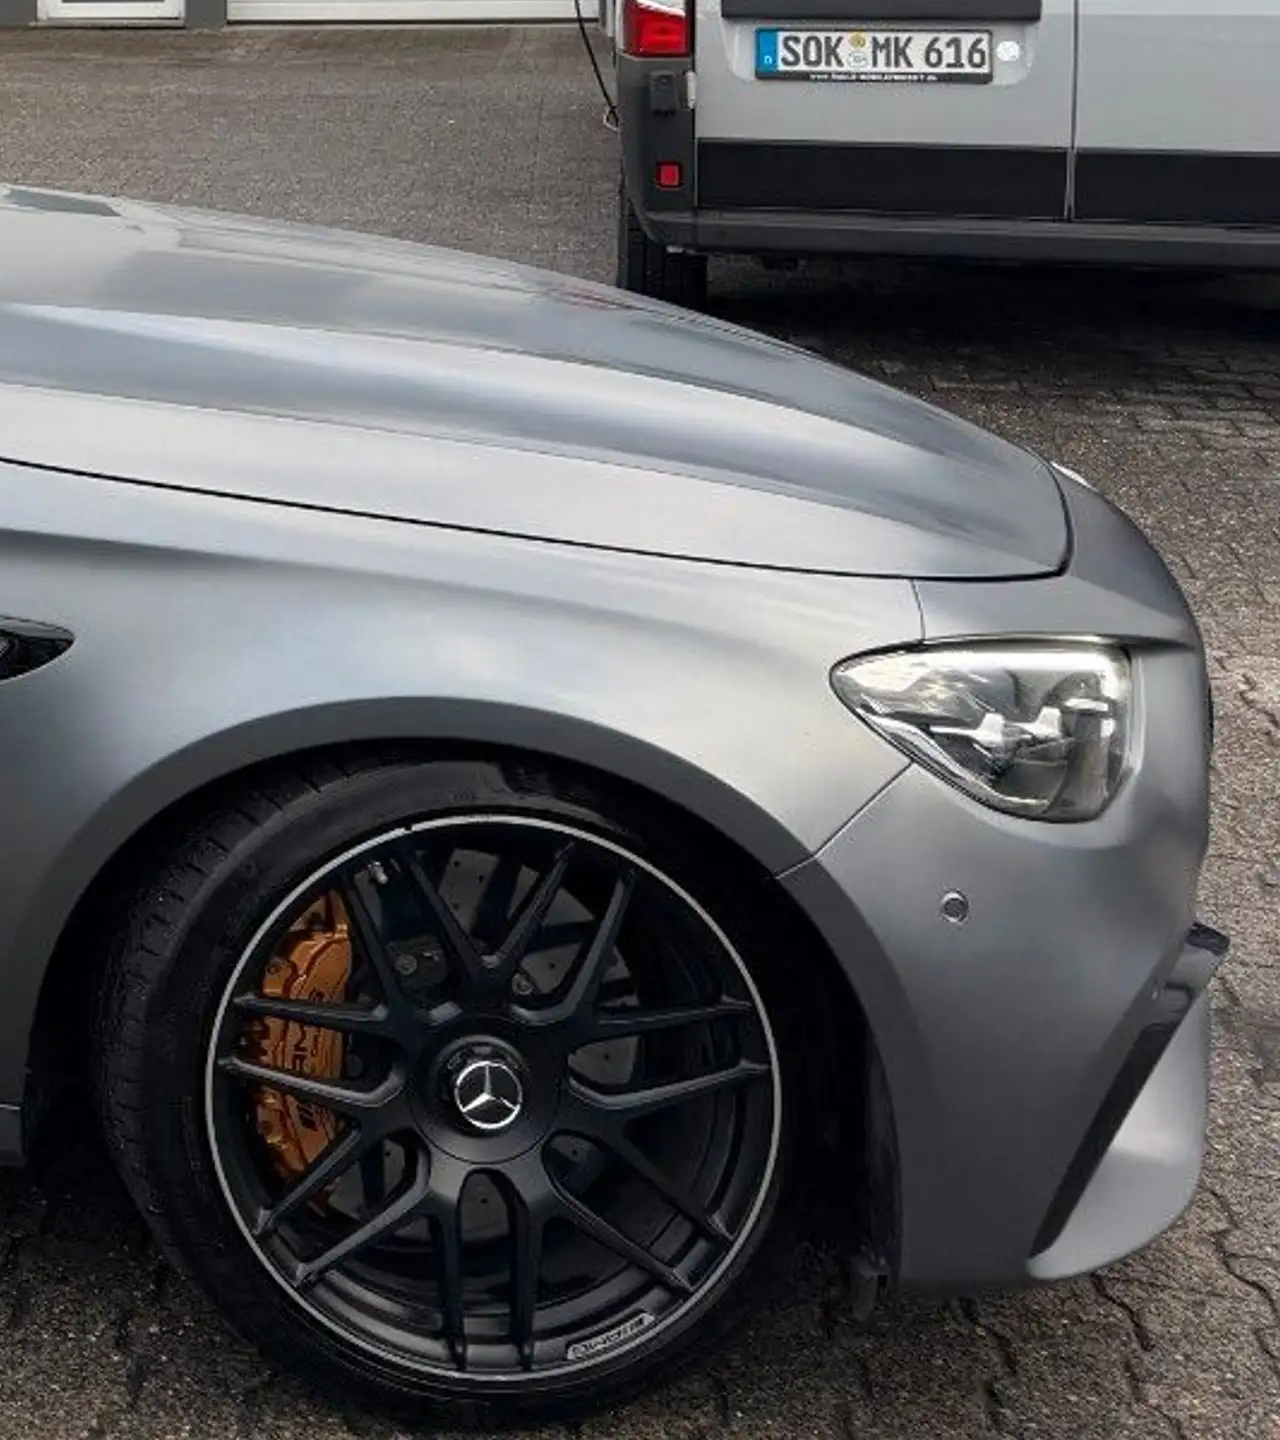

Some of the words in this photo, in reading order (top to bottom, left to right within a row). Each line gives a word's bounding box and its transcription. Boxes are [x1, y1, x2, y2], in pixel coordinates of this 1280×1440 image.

[781, 35, 844, 67] SOK
[871, 36, 914, 68] MK
[924, 36, 987, 69] 616
